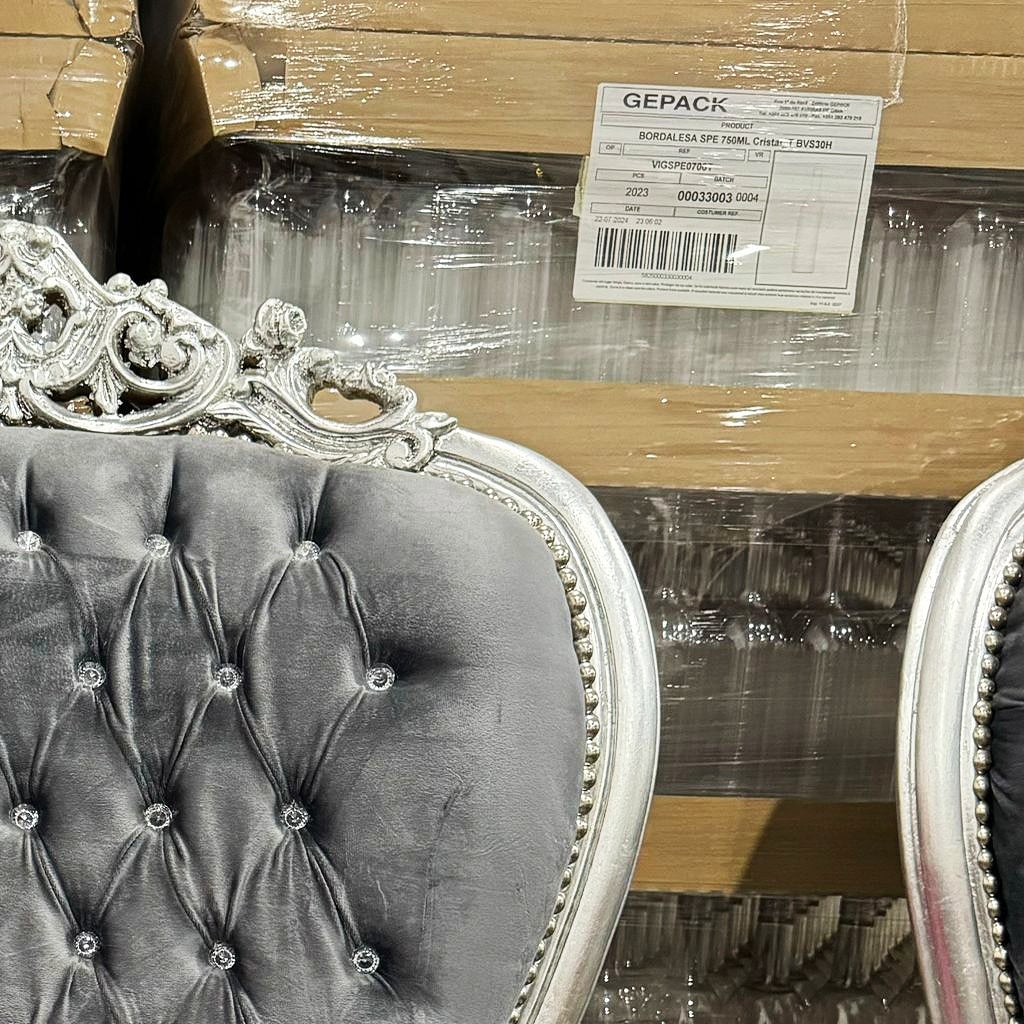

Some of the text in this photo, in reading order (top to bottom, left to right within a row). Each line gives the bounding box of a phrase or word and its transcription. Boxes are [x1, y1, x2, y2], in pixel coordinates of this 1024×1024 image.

[623, 92, 729, 113] GEPACK
[638, 131, 698, 143] BORDALESA
[699, 134, 719, 144] SPE
[721, 136, 751, 146] 750ML
[796, 139, 833, 150] BVS30H
[625, 187, 649, 197] 2023
[677, 191, 759, 203] 00033003 0004
